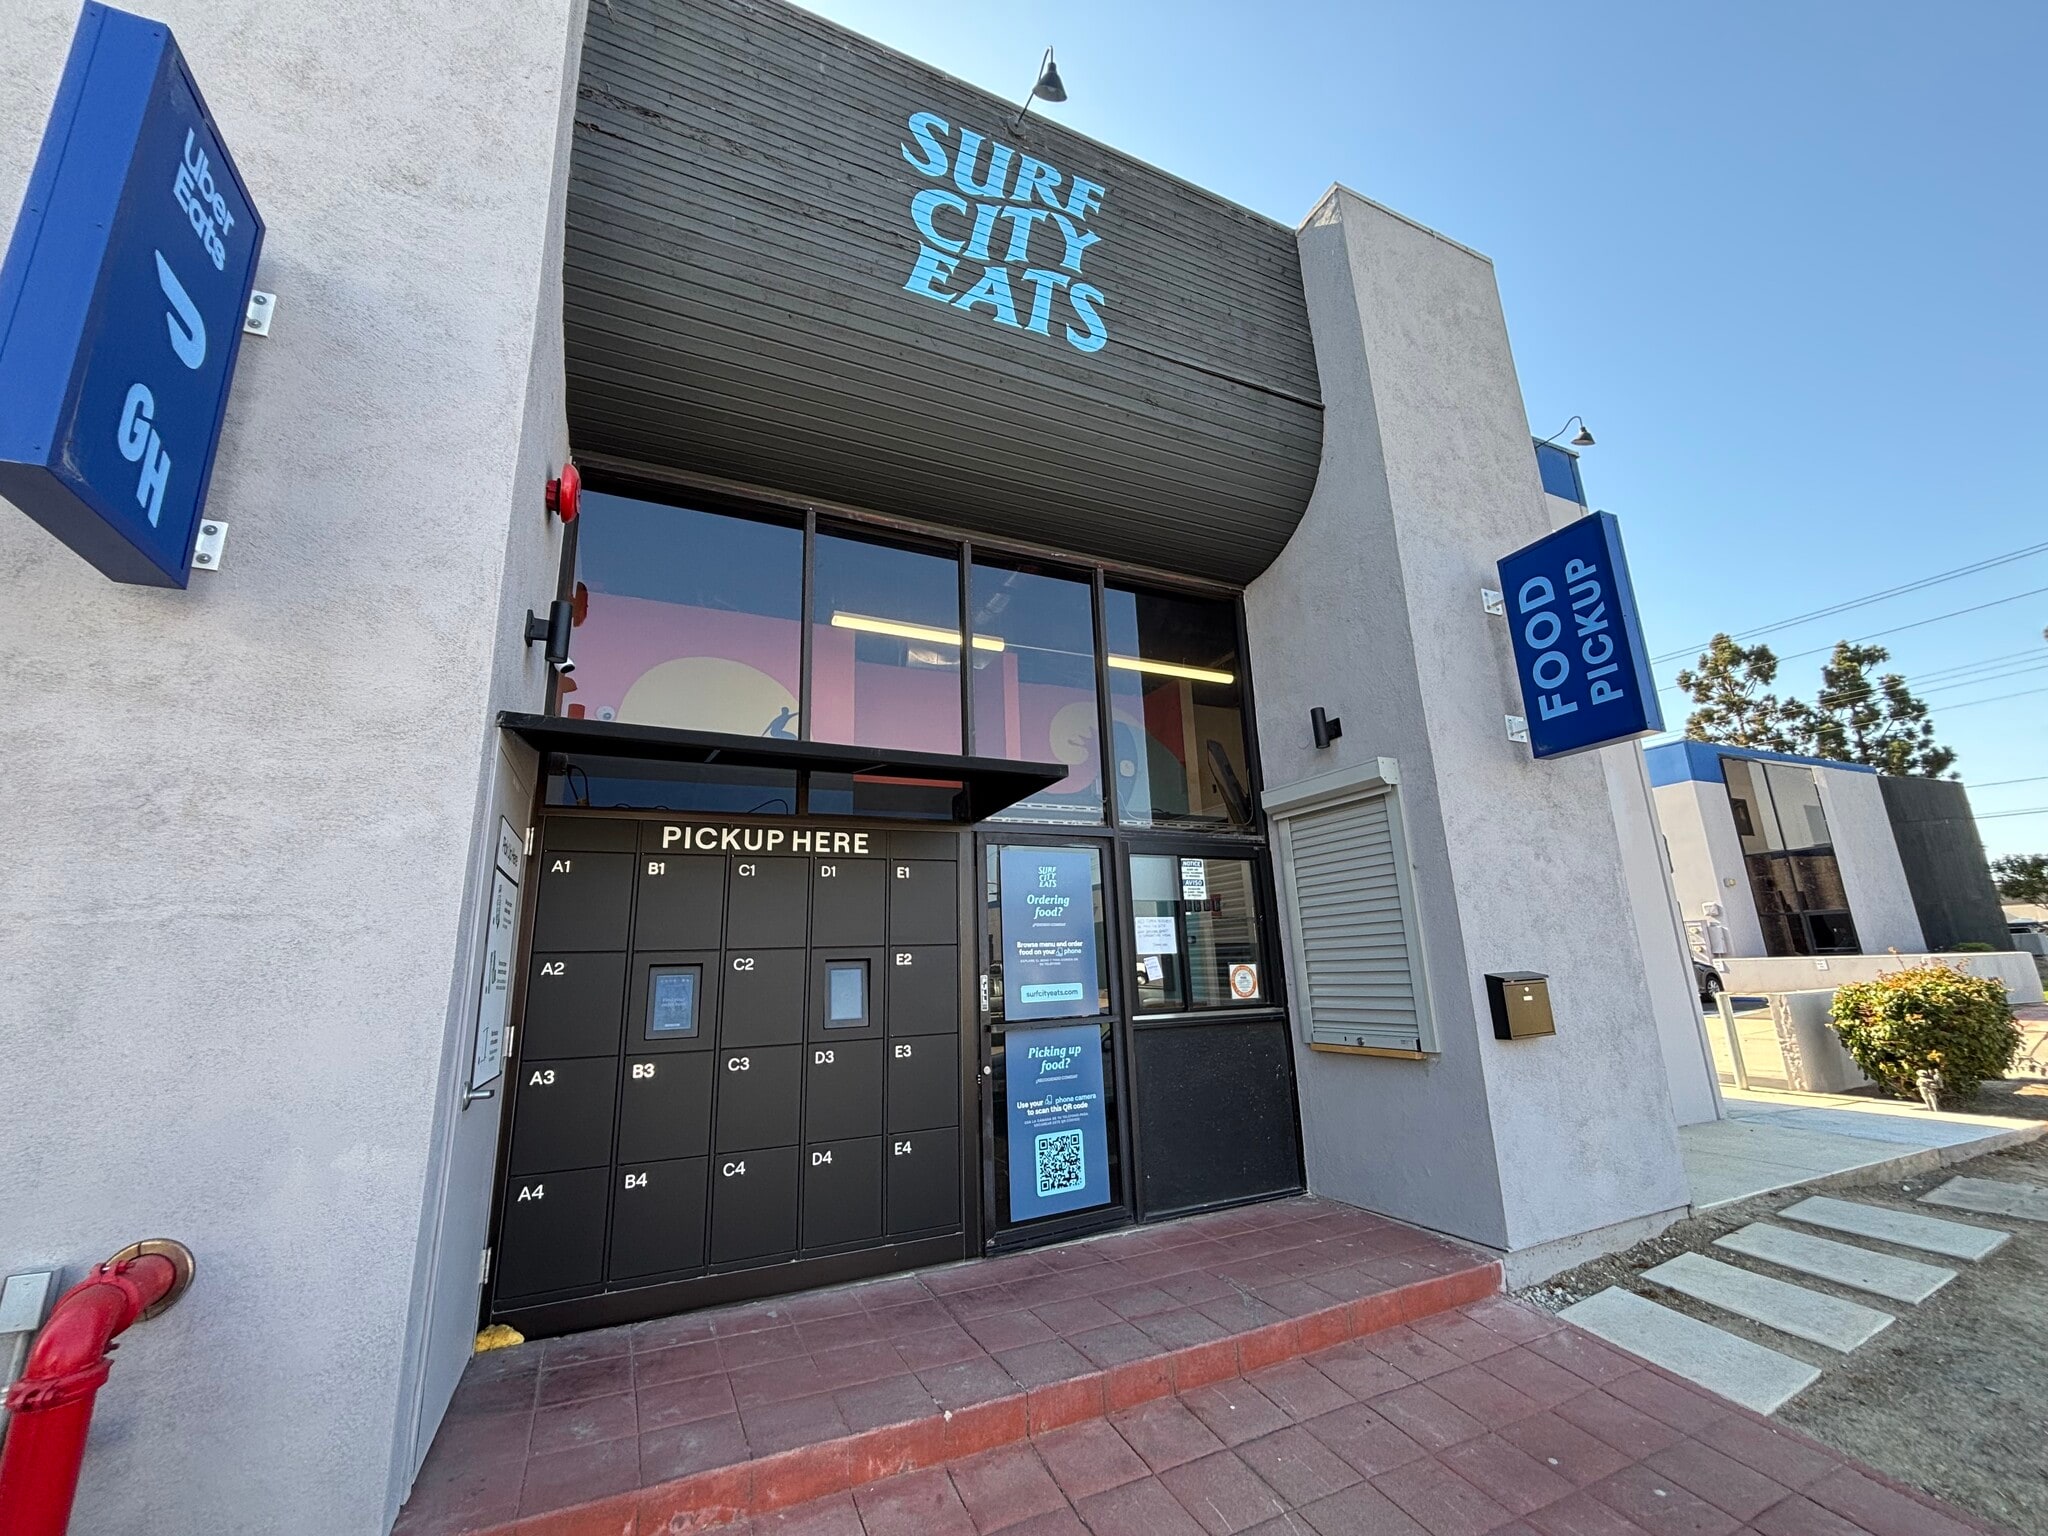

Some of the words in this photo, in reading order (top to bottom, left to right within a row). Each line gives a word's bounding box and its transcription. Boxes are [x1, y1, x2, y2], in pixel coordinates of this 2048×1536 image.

[901, 112, 1105, 221] SURF
[184, 127, 235, 236] Uber
[173, 161, 226, 271] Eats
[911, 189, 1102, 273] CITY
[902, 240, 1108, 352] EATS
[117, 383, 171, 528] GH
[1565, 558, 1624, 705] PICKUP
[1518, 575, 1579, 721] FOOD
[662, 826, 785, 851] PICKUP
[792, 830, 869, 854] HERE
[551, 859, 571, 873] A1
[647, 862, 665, 875] B1
[738, 864, 756, 877] C1
[821, 865, 836, 877] D1
[896, 866, 910, 878] E1
[1038, 866, 1057, 875] SURF
[1038, 879, 1057, 888] EATS
[1039, 872, 1057, 882] CITY
[1026, 894, 1070, 907] Ordering
[1034, 907, 1063, 920] food?
[896, 953, 912, 966] E2
[1042, 949, 1056, 957] your
[540, 961, 565, 976] A2
[733, 957, 755, 971] C2
[1026, 989, 1079, 998] surfcityeats.com
[814, 1050, 835, 1064] D3
[895, 1044, 912, 1057] E3
[1028, 1045, 1066, 1059] Picking
[1068, 1045, 1082, 1057] up
[632, 1063, 655, 1079] B3
[727, 1056, 750, 1071] C3
[1040, 1058, 1071, 1075] food?
[529, 1069, 555, 1086] A3
[1016, 1101, 1029, 1109] Use
[1029, 1100, 1043, 1108] your
[1055, 1096, 1074, 1105] phone
[1074, 1093, 1097, 1101] camera
[1027, 1108, 1034, 1116] to
[1035, 1107, 1050, 1115] scan
[1062, 1103, 1073, 1112] QR
[1073, 1101, 1088, 1109] code
[894, 1141, 912, 1155] E4
[812, 1150, 833, 1165] D4
[722, 1161, 746, 1177] C4
[624, 1172, 648, 1189] B4
[517, 1184, 545, 1202] A4
